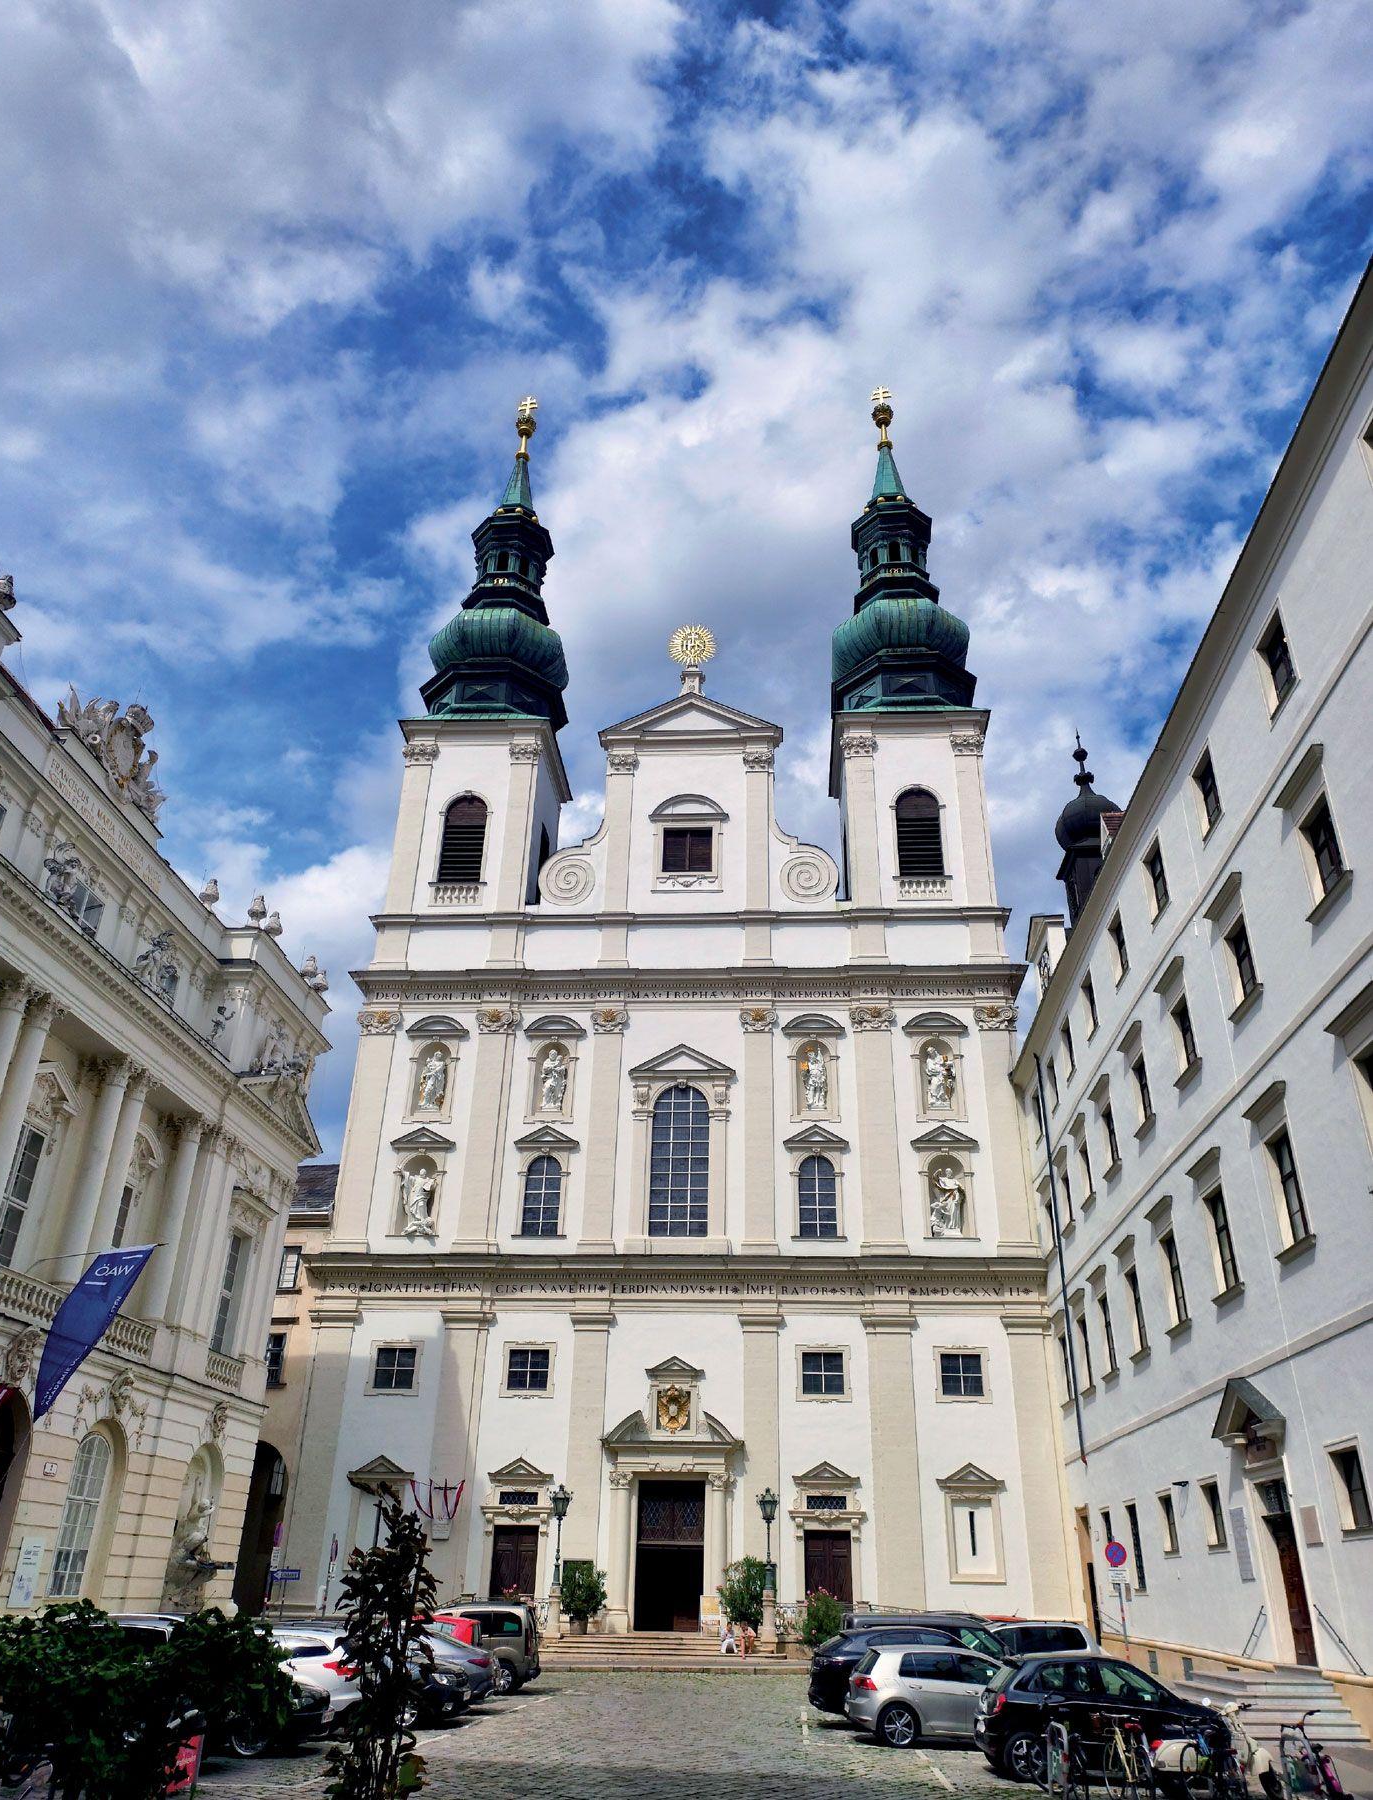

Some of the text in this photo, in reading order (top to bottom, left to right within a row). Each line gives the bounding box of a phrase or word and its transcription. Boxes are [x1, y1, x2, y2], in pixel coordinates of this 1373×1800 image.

[97, 808, 115, 835] MARIA
[375, 991, 400, 1000] DEO
[403, 992, 453, 1001] VICTORI
[744, 989, 772, 998] HOC
[773, 990, 786, 998] IN
[788, 990, 851, 998] MEMORIAM
[890, 988, 948, 996] VIRGINIS
[94, 1263, 135, 1277] ÖAW
[367, 1281, 423, 1293] IGNATII
[433, 1282, 450, 1293] ET
[538, 1283, 598, 1294] XAVERII
[612, 1283, 706, 1294] FERDINANDVS
[45, 1367, 72, 1406] AKADEMIE
